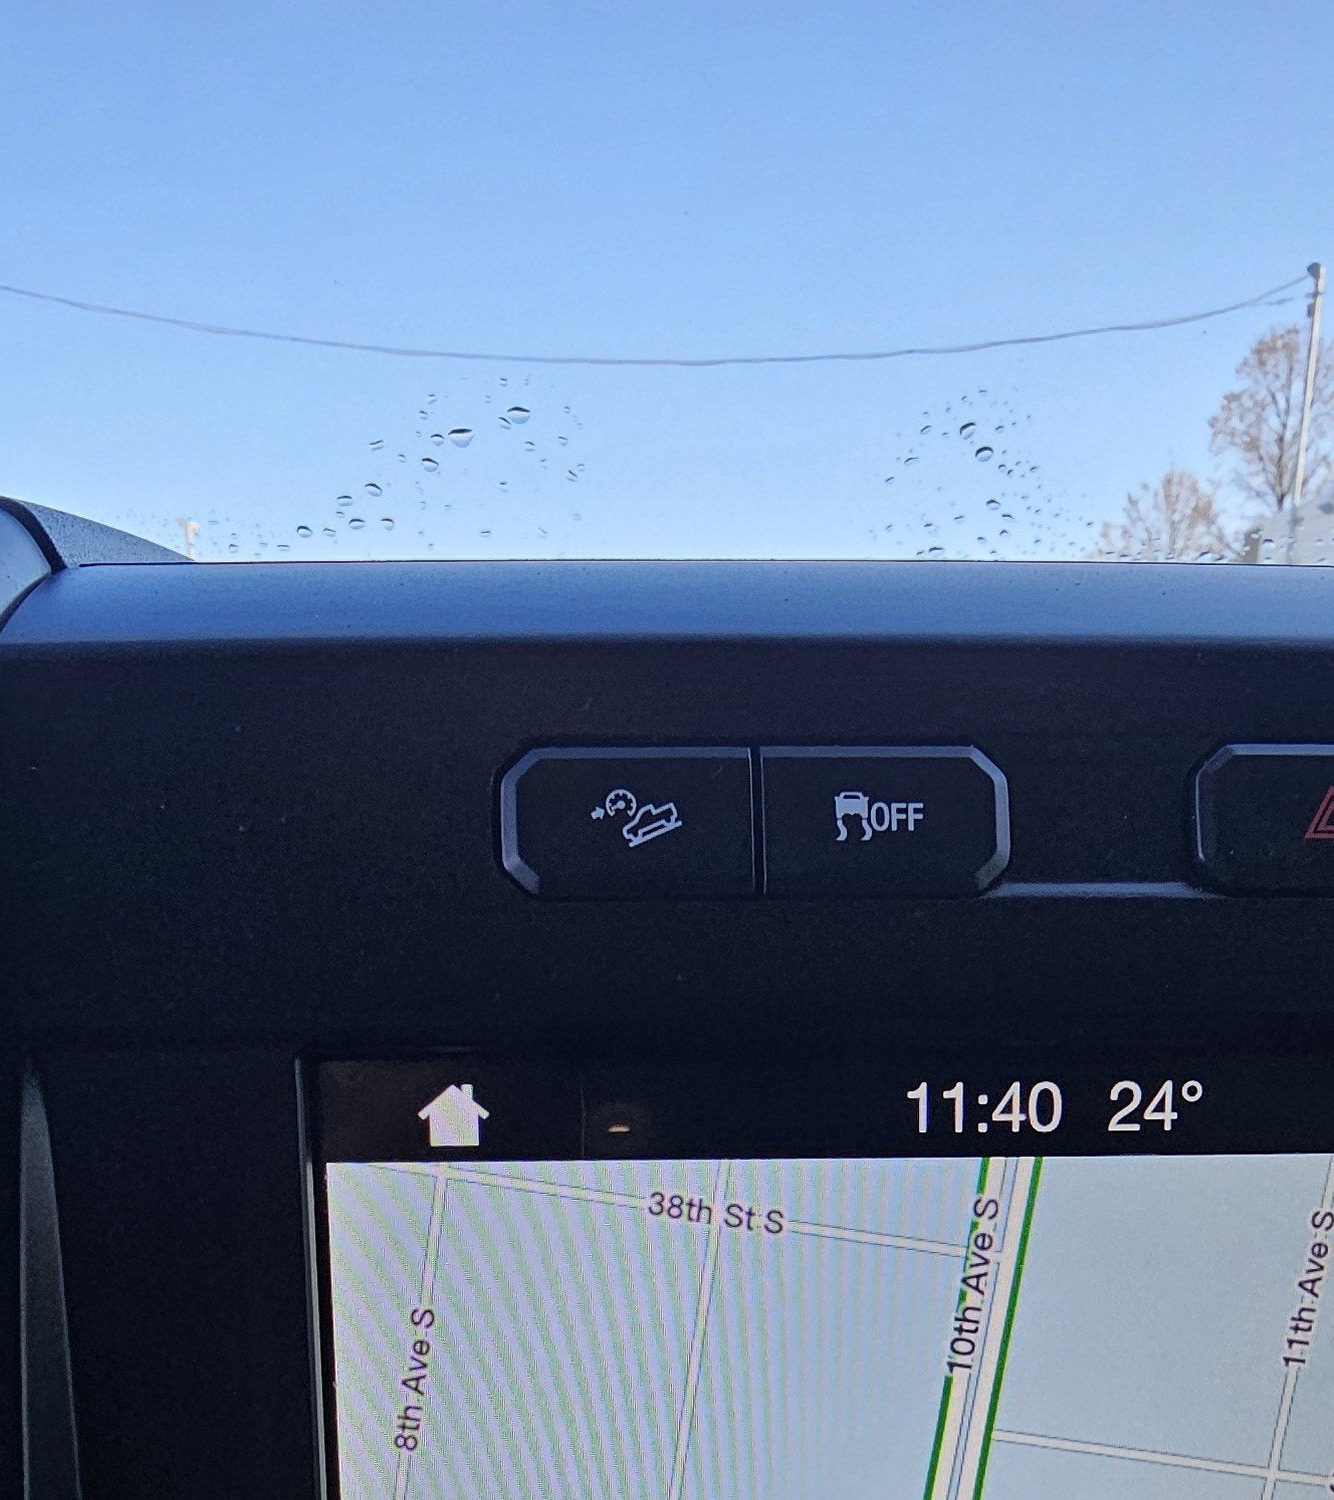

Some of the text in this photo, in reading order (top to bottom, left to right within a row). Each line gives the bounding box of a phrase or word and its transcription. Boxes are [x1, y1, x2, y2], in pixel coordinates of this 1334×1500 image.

[870, 802, 924, 832] OFF
[907, 1080, 1203, 1133] 11:40 24°
[649, 1191, 784, 1233] 38th St S
[946, 1198, 999, 1374] 10th Ave S
[1282, 1210, 1334, 1367] 11th Ave S
[394, 1308, 435, 1450] 8th Ave S
